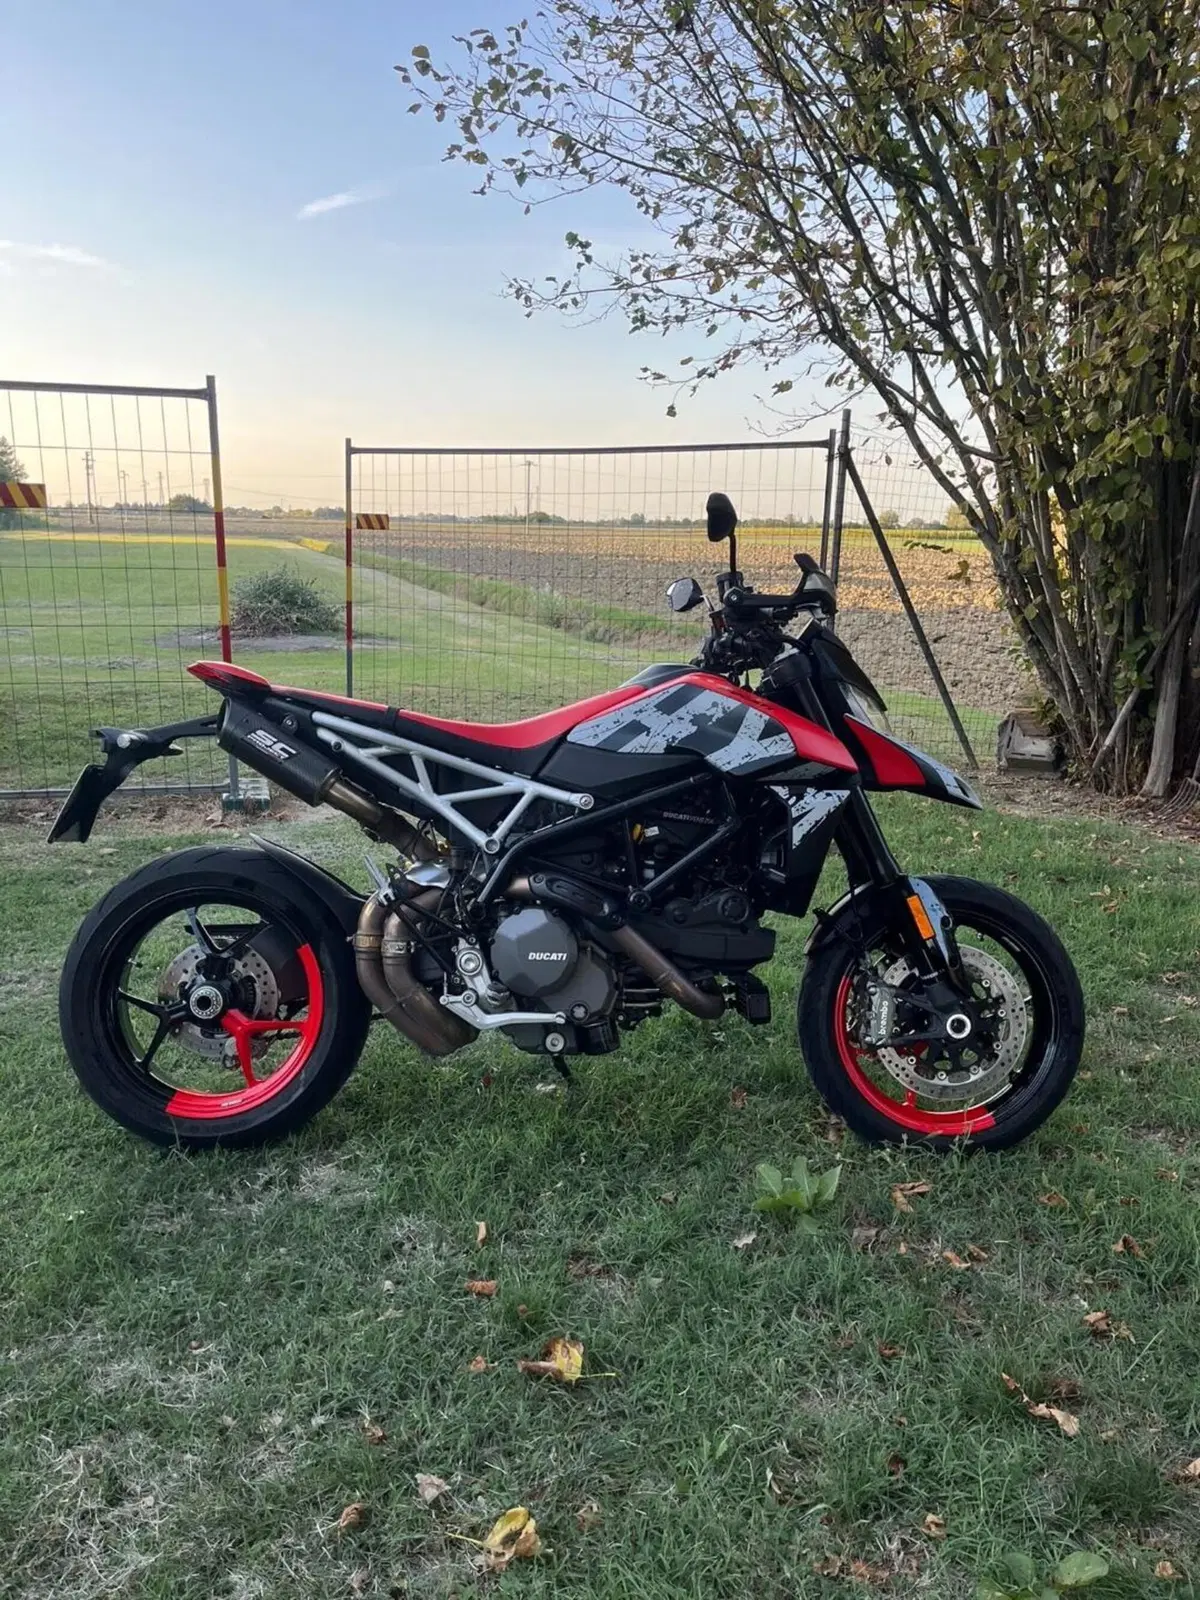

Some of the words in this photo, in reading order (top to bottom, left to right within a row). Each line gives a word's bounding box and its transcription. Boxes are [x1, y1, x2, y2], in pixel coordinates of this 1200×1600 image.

[250, 729, 297, 757] SC
[528, 952, 567, 961] DUCATI
[878, 1000, 889, 1035] brembo
